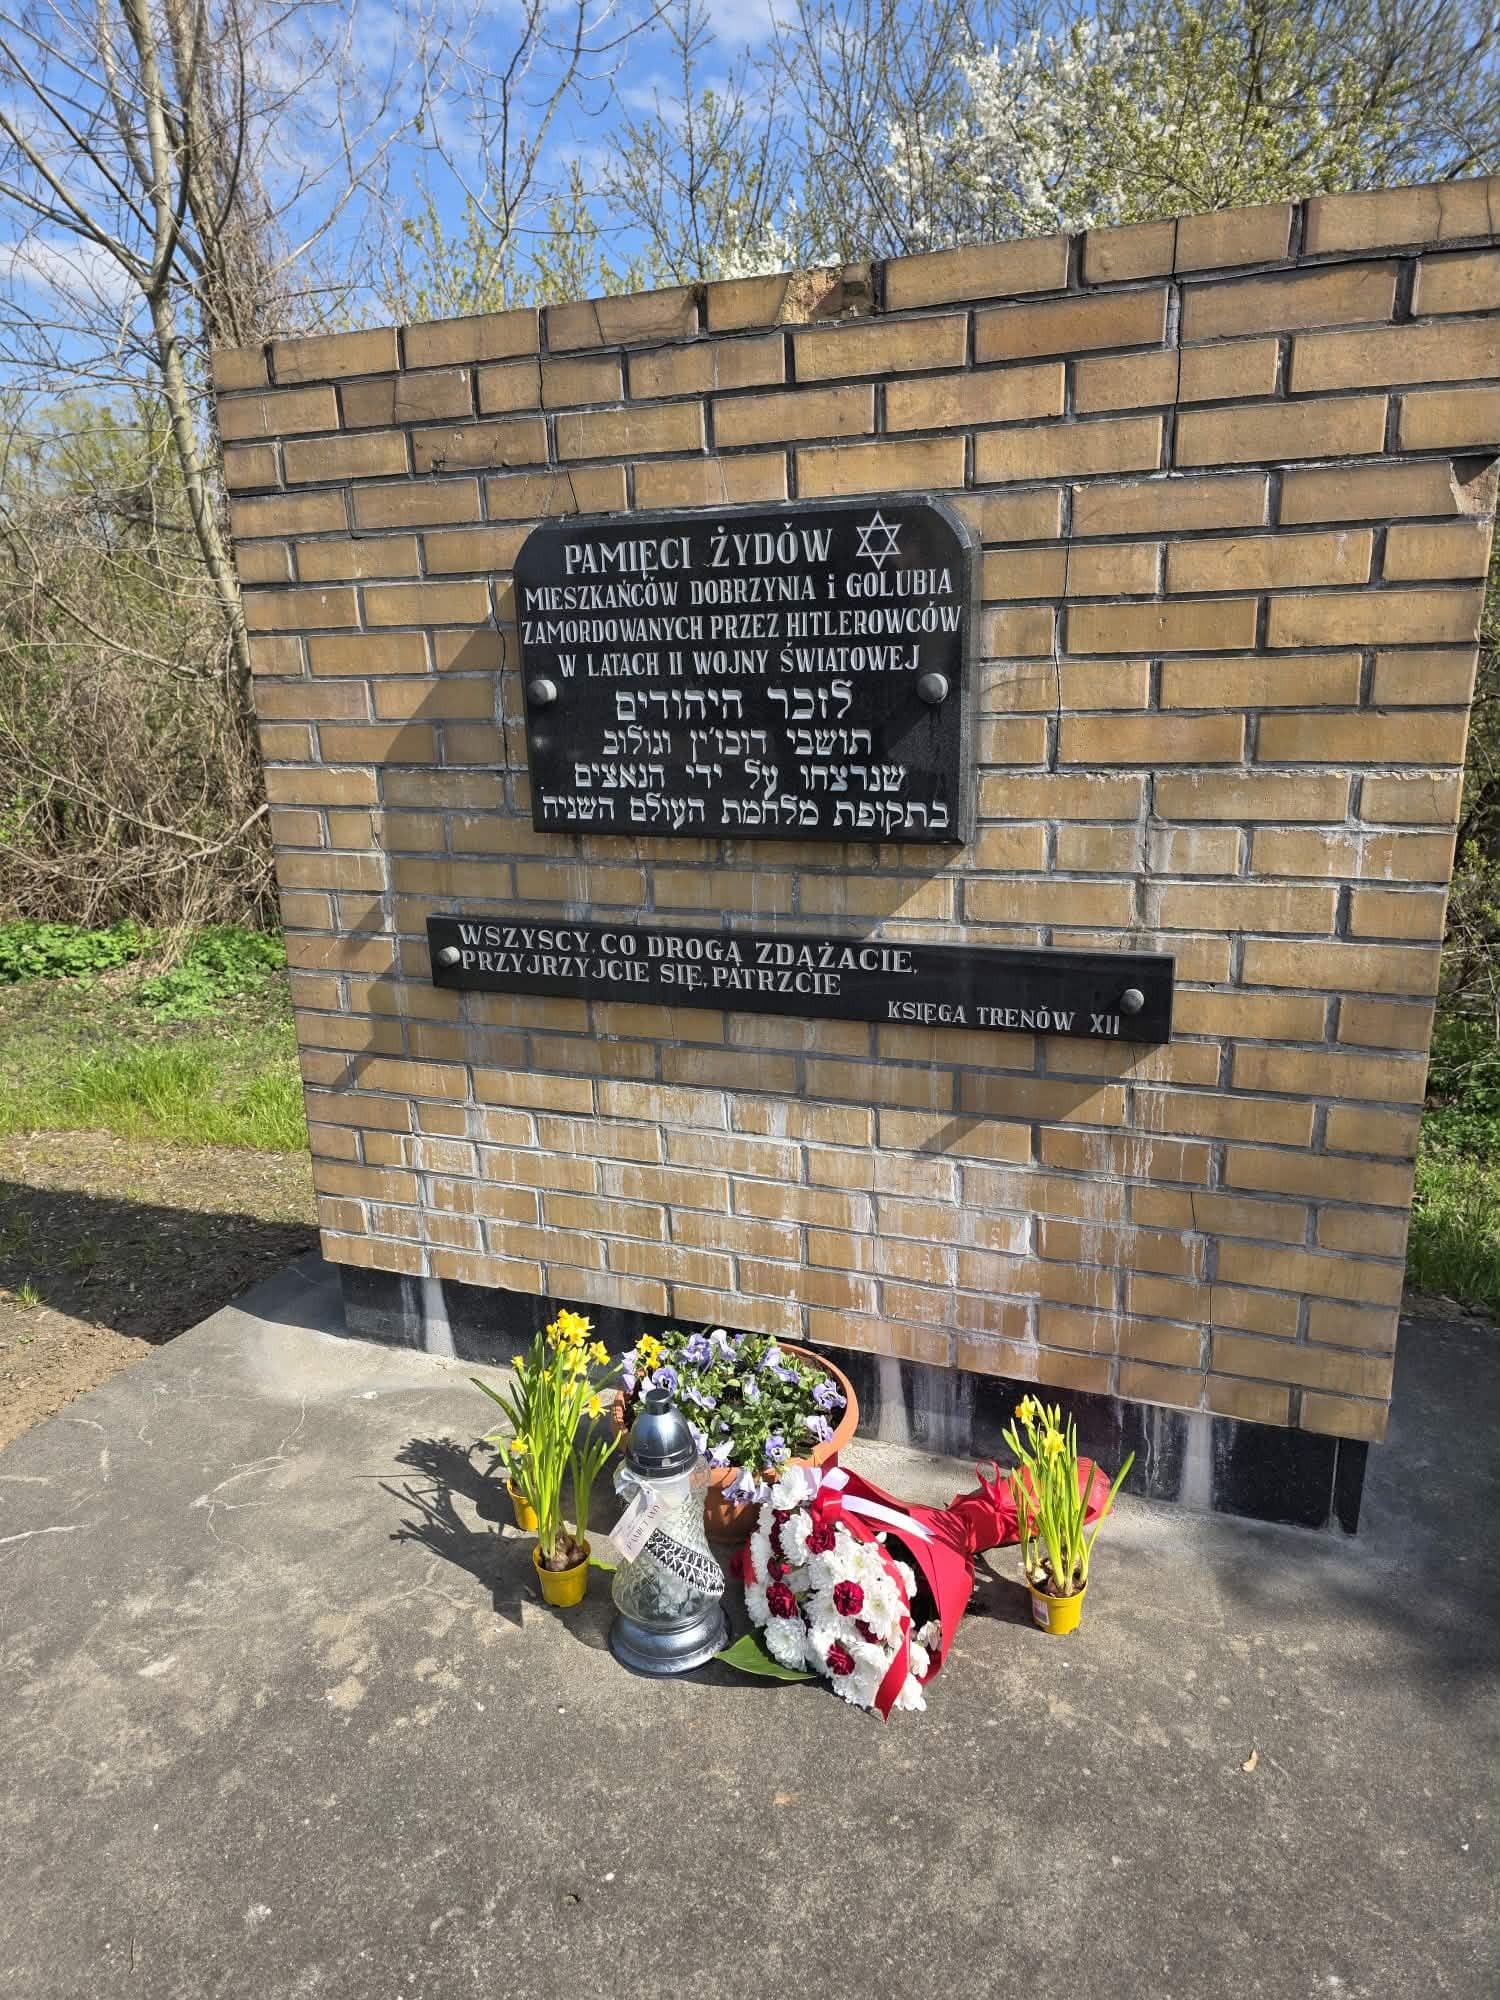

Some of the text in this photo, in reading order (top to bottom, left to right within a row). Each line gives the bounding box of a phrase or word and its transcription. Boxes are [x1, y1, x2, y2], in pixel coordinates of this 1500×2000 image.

[564, 521, 833, 580] PAMIĘCI ŻYDÓW
[525, 567, 953, 611] MIESZKAŃCÓW DOBRZYNIA i GOLUBIA
[521, 601, 962, 645] ZAMORDOWANYCH PRZEZ HITLEROWCÓW
[558, 641, 920, 678] W LATACH II WOJNY ŚWIATOWEJ
[616, 679, 853, 720] לזכר היהודים
[602, 725, 671, 755] וגולוב
[786, 728, 872, 755] תושבי
[575, 758, 907, 800] שנרצחו על ידי הנאצים
[542, 792, 949, 835] בתקופת מלחמת העולם השניה
[460, 950, 650, 983] PRZYJRZYJCIE
[600, 933, 637, 956] CO
[648, 936, 743, 967] DROGĄ
[887, 1000, 1120, 1035] KSIĘGA TRENÓW XII
